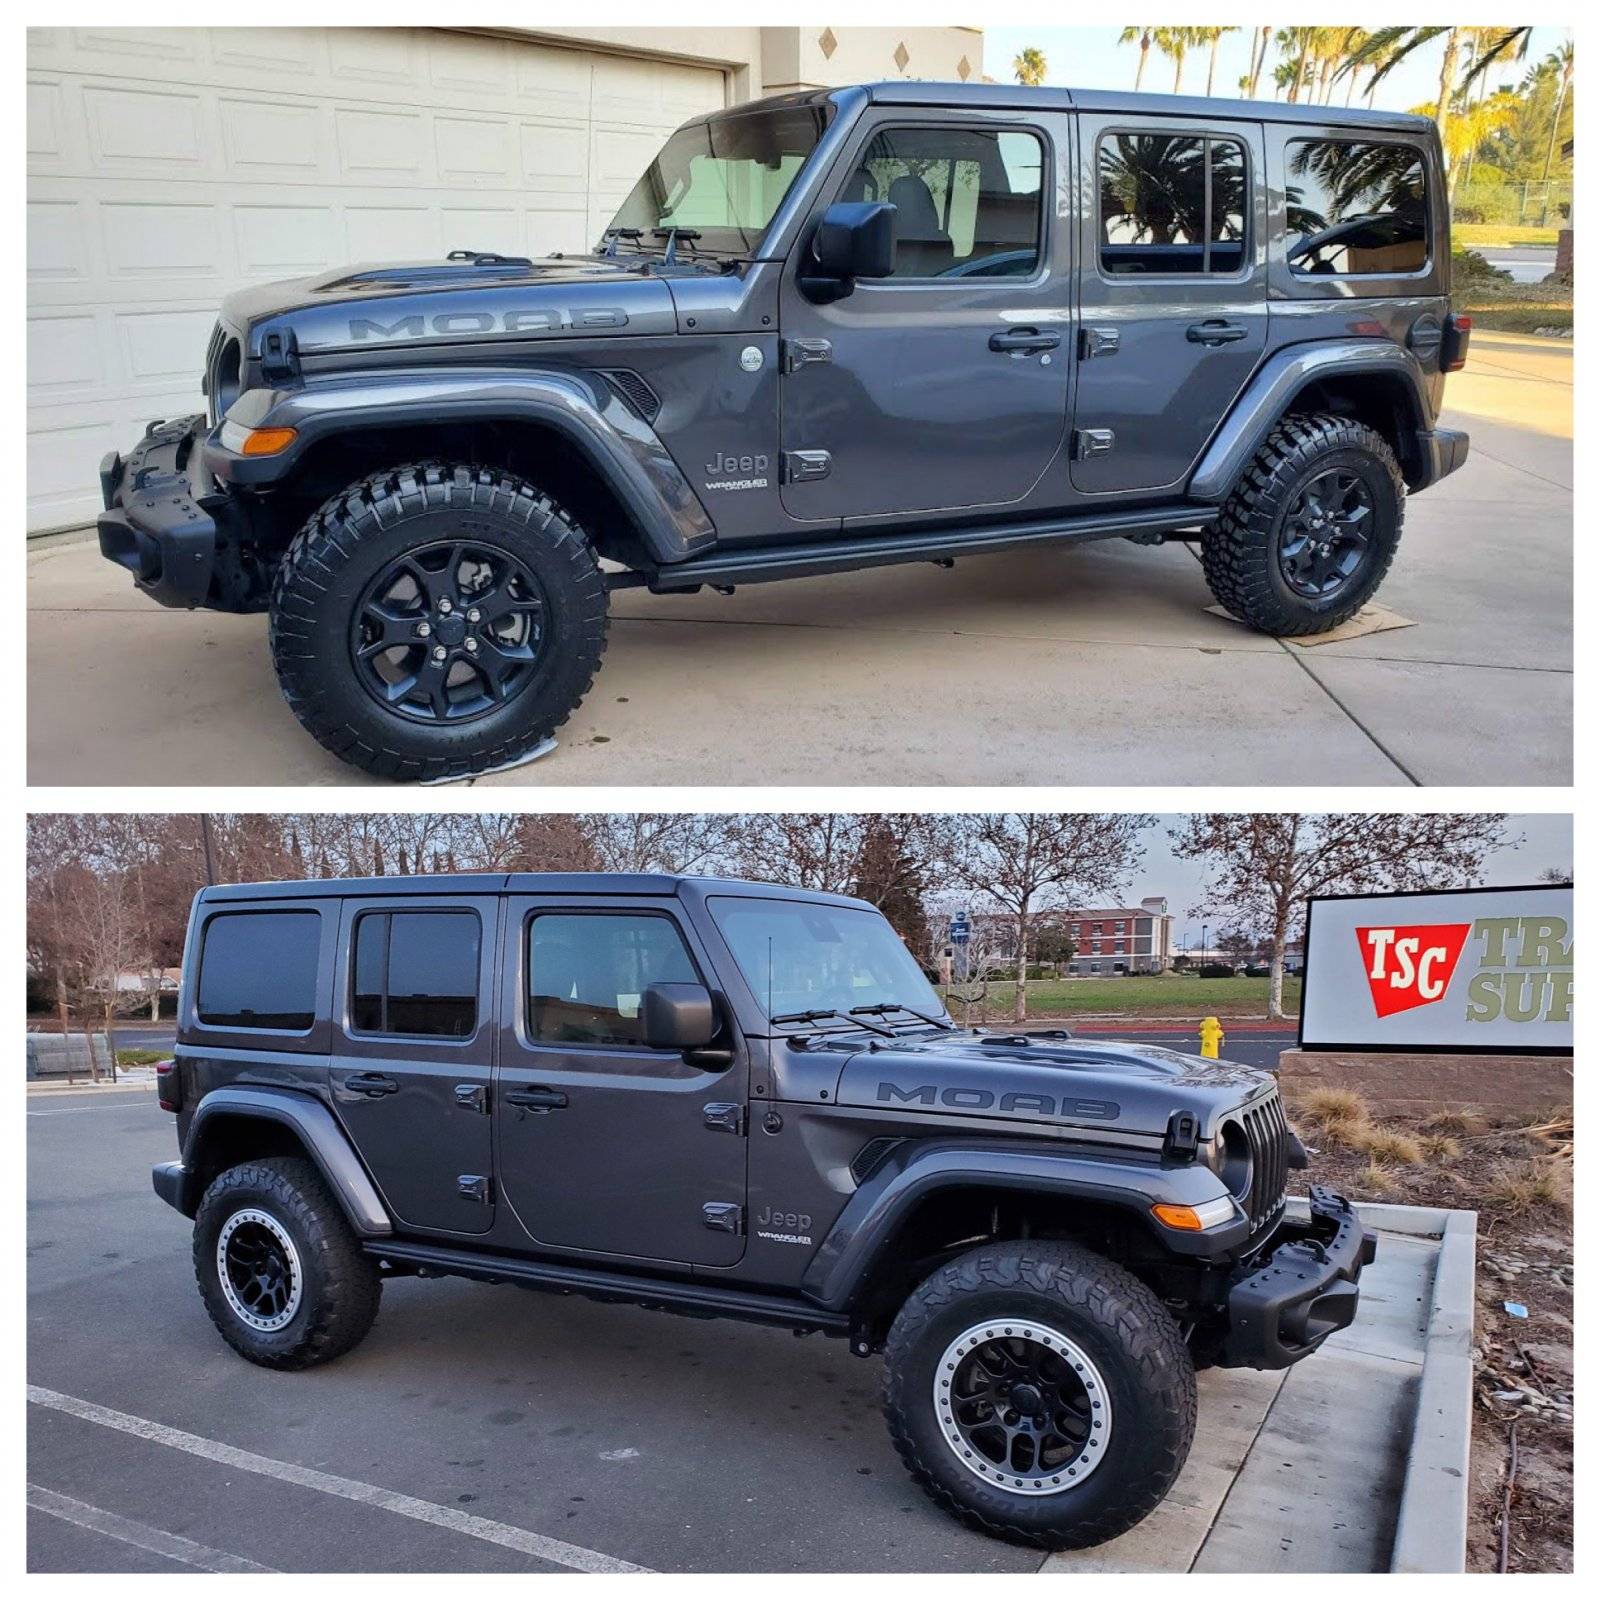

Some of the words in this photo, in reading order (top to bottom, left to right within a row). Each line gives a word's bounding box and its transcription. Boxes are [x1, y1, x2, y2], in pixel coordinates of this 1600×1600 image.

[349, 306, 629, 339] MOAB
[705, 452, 769, 475] Jeep
[1474, 916, 1573, 967] TR
[1367, 929, 1447, 1000] TSC
[876, 1082, 1121, 1121] MOAB
[757, 1206, 812, 1232] Jeep
